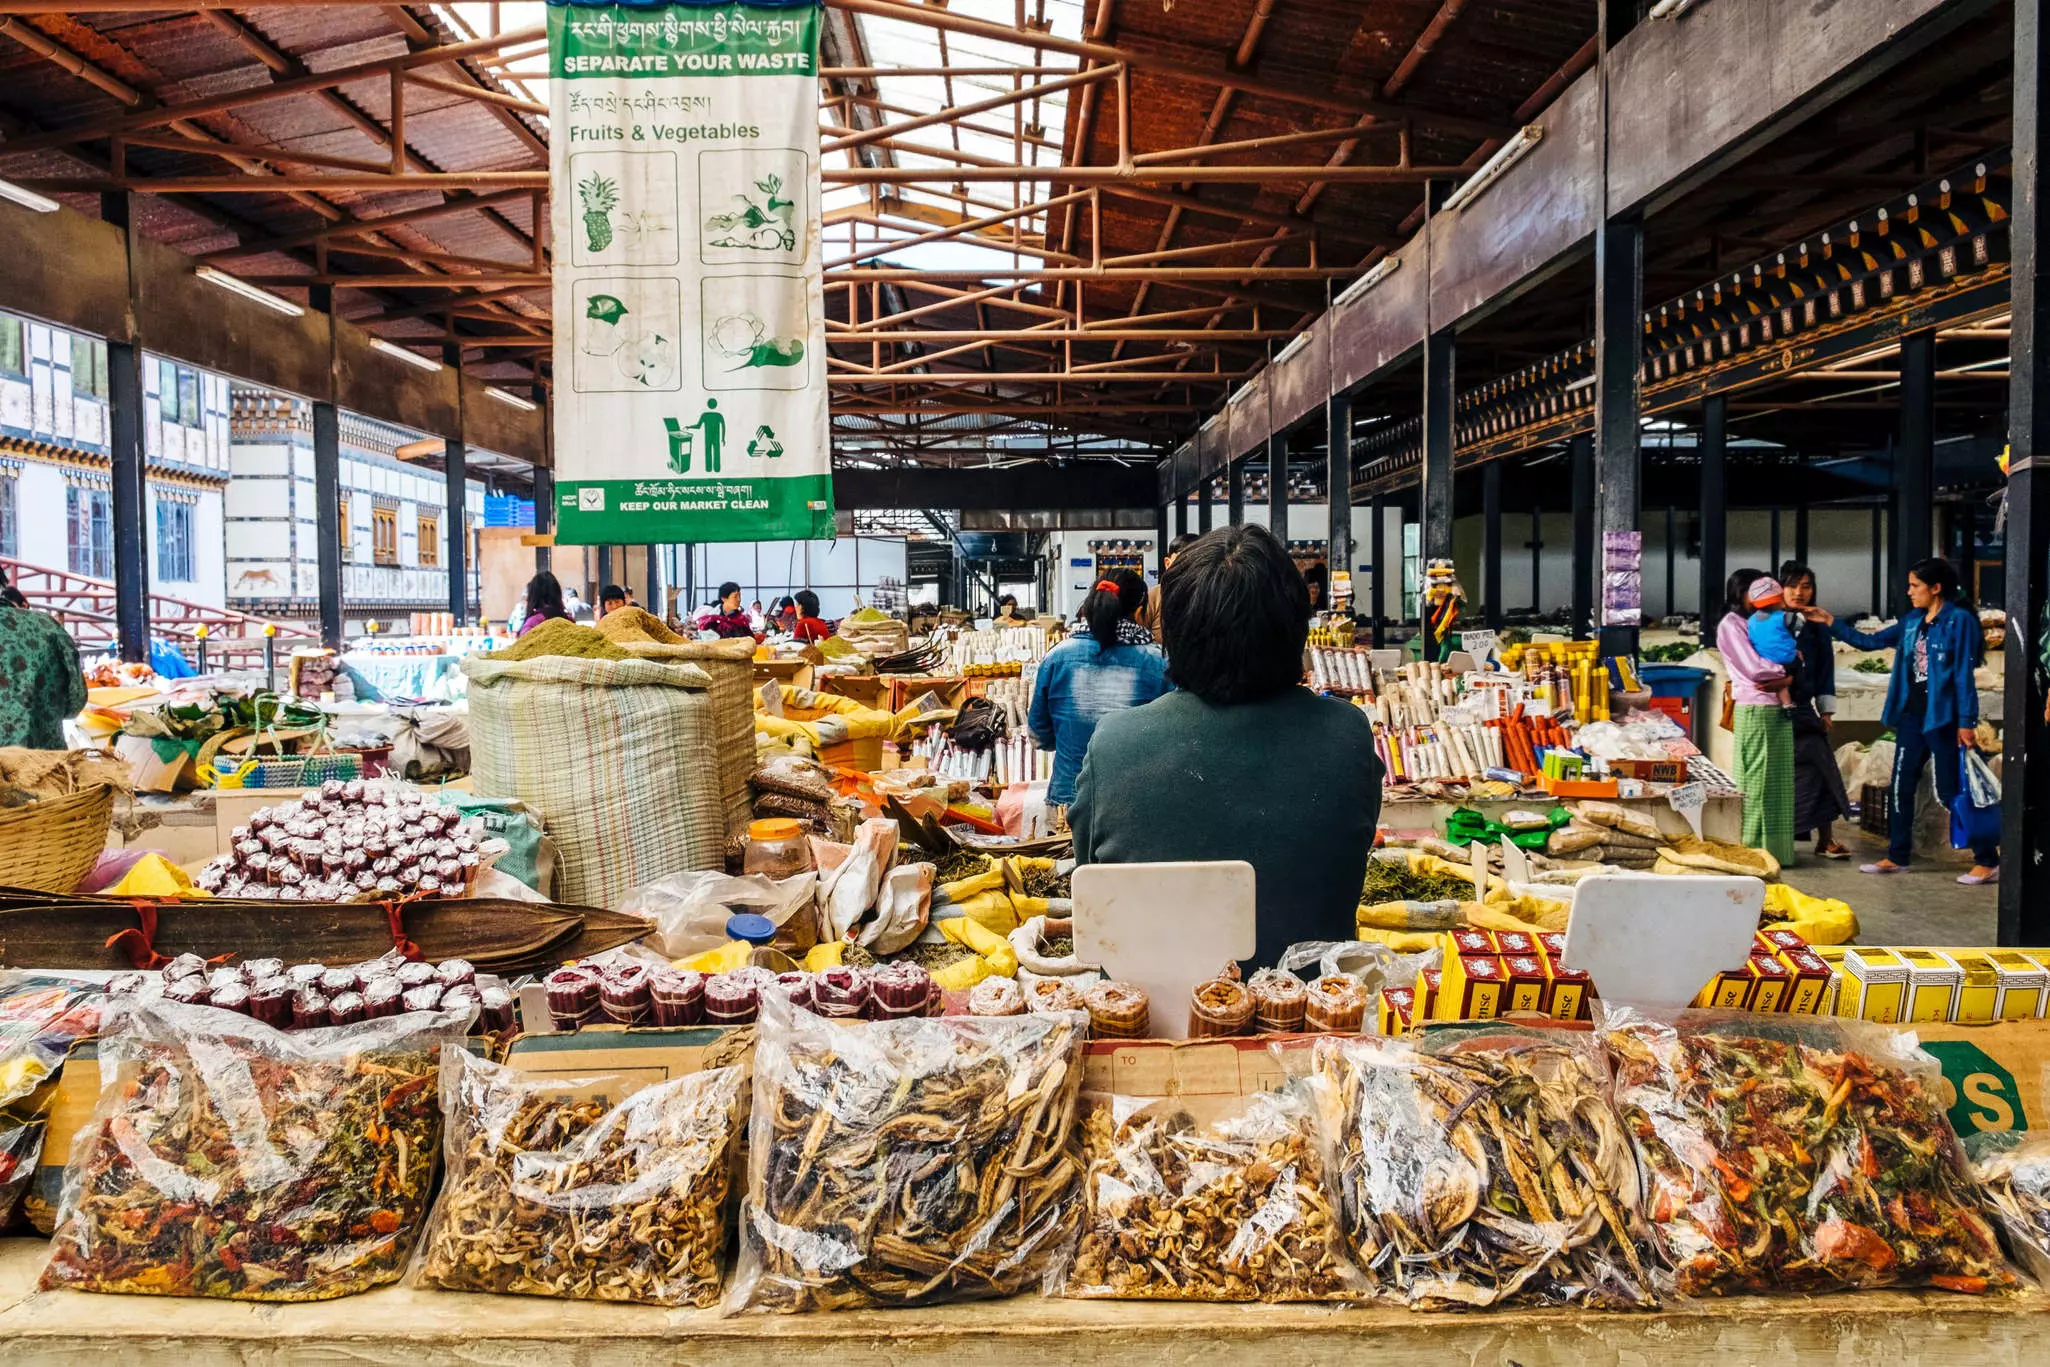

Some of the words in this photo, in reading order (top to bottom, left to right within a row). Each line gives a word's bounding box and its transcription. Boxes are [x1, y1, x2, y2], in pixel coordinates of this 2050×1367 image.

[564, 54, 668, 73] SEPARATE
[672, 53, 733, 71] YOUR
[737, 52, 810, 69] WASTE
[570, 125, 624, 142] Fruits
[631, 125, 645, 140] &
[652, 122, 760, 143] Vegetables
[620, 501, 649, 511] KEEP
[653, 501, 677, 511] OUR
[680, 500, 728, 511] MARKET
[731, 499, 769, 510] CLEAN
[1121, 1056, 1136, 1065] TO
